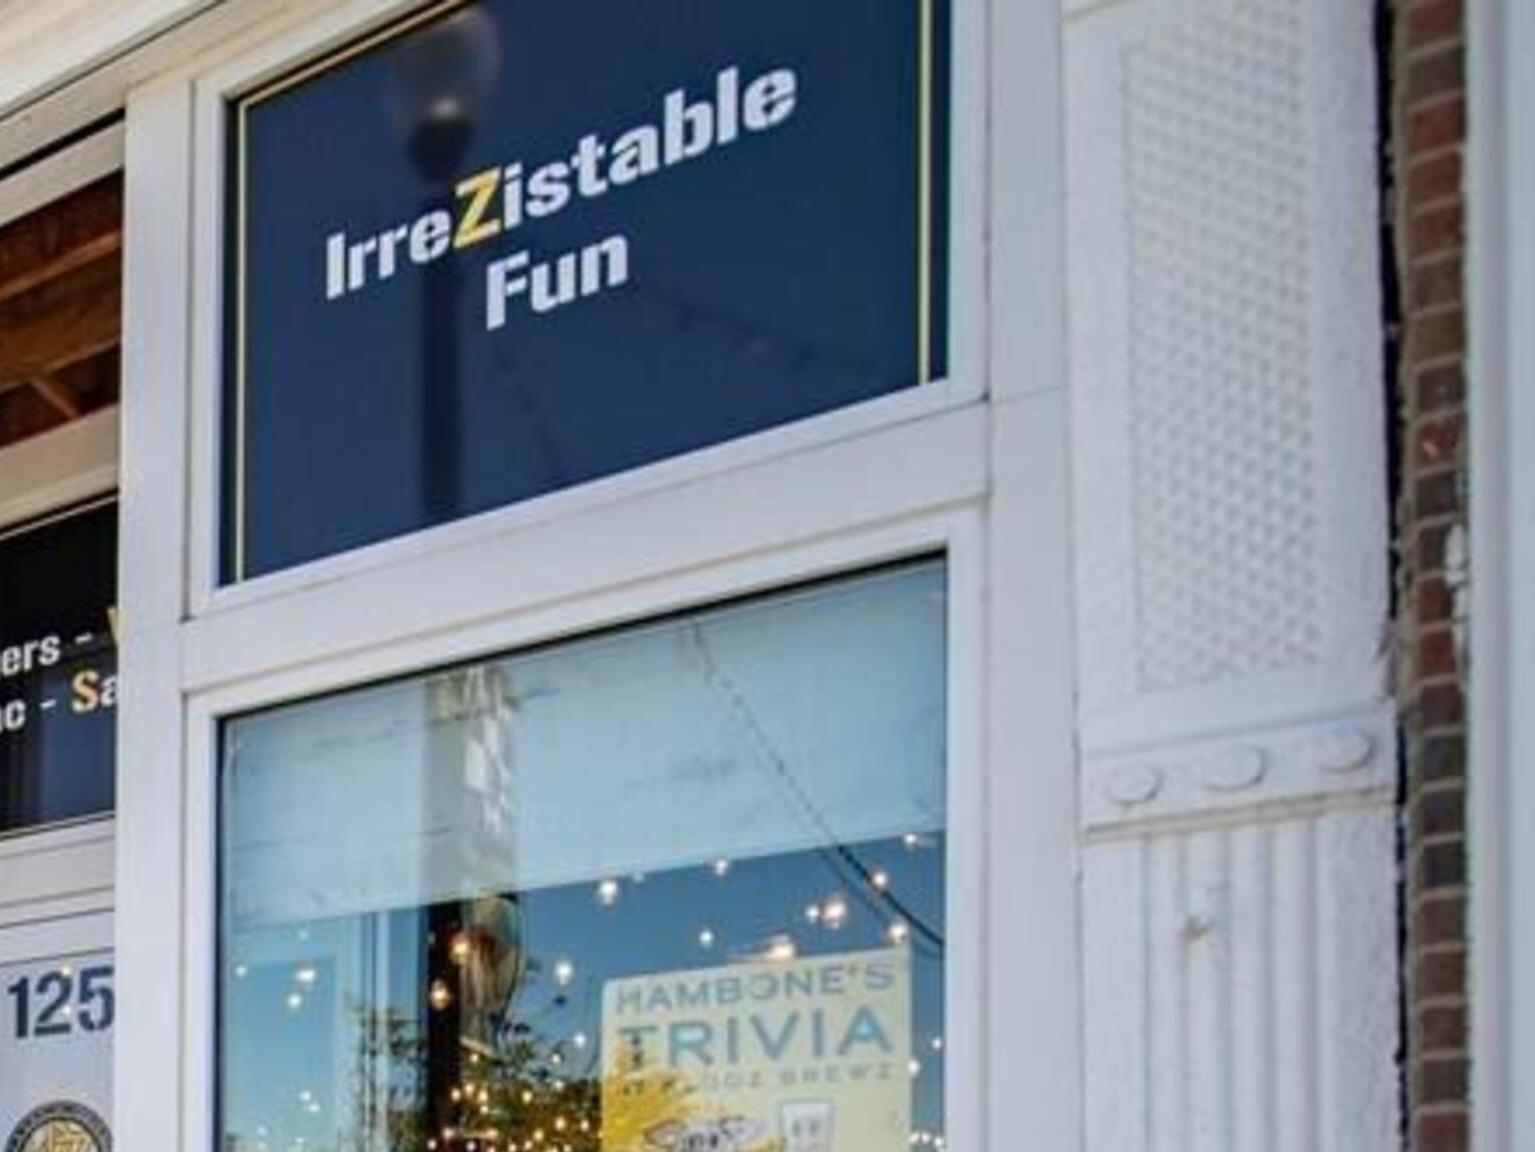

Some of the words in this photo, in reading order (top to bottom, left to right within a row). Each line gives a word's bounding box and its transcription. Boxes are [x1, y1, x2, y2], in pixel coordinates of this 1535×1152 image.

[325, 66, 797, 300] IrreZistable
[485, 233, 630, 331] Fun
[6, 965, 115, 1039] 125
[616, 961, 895, 1014] HAMBONE'S
[615, 1003, 897, 1075] TRIVIA
